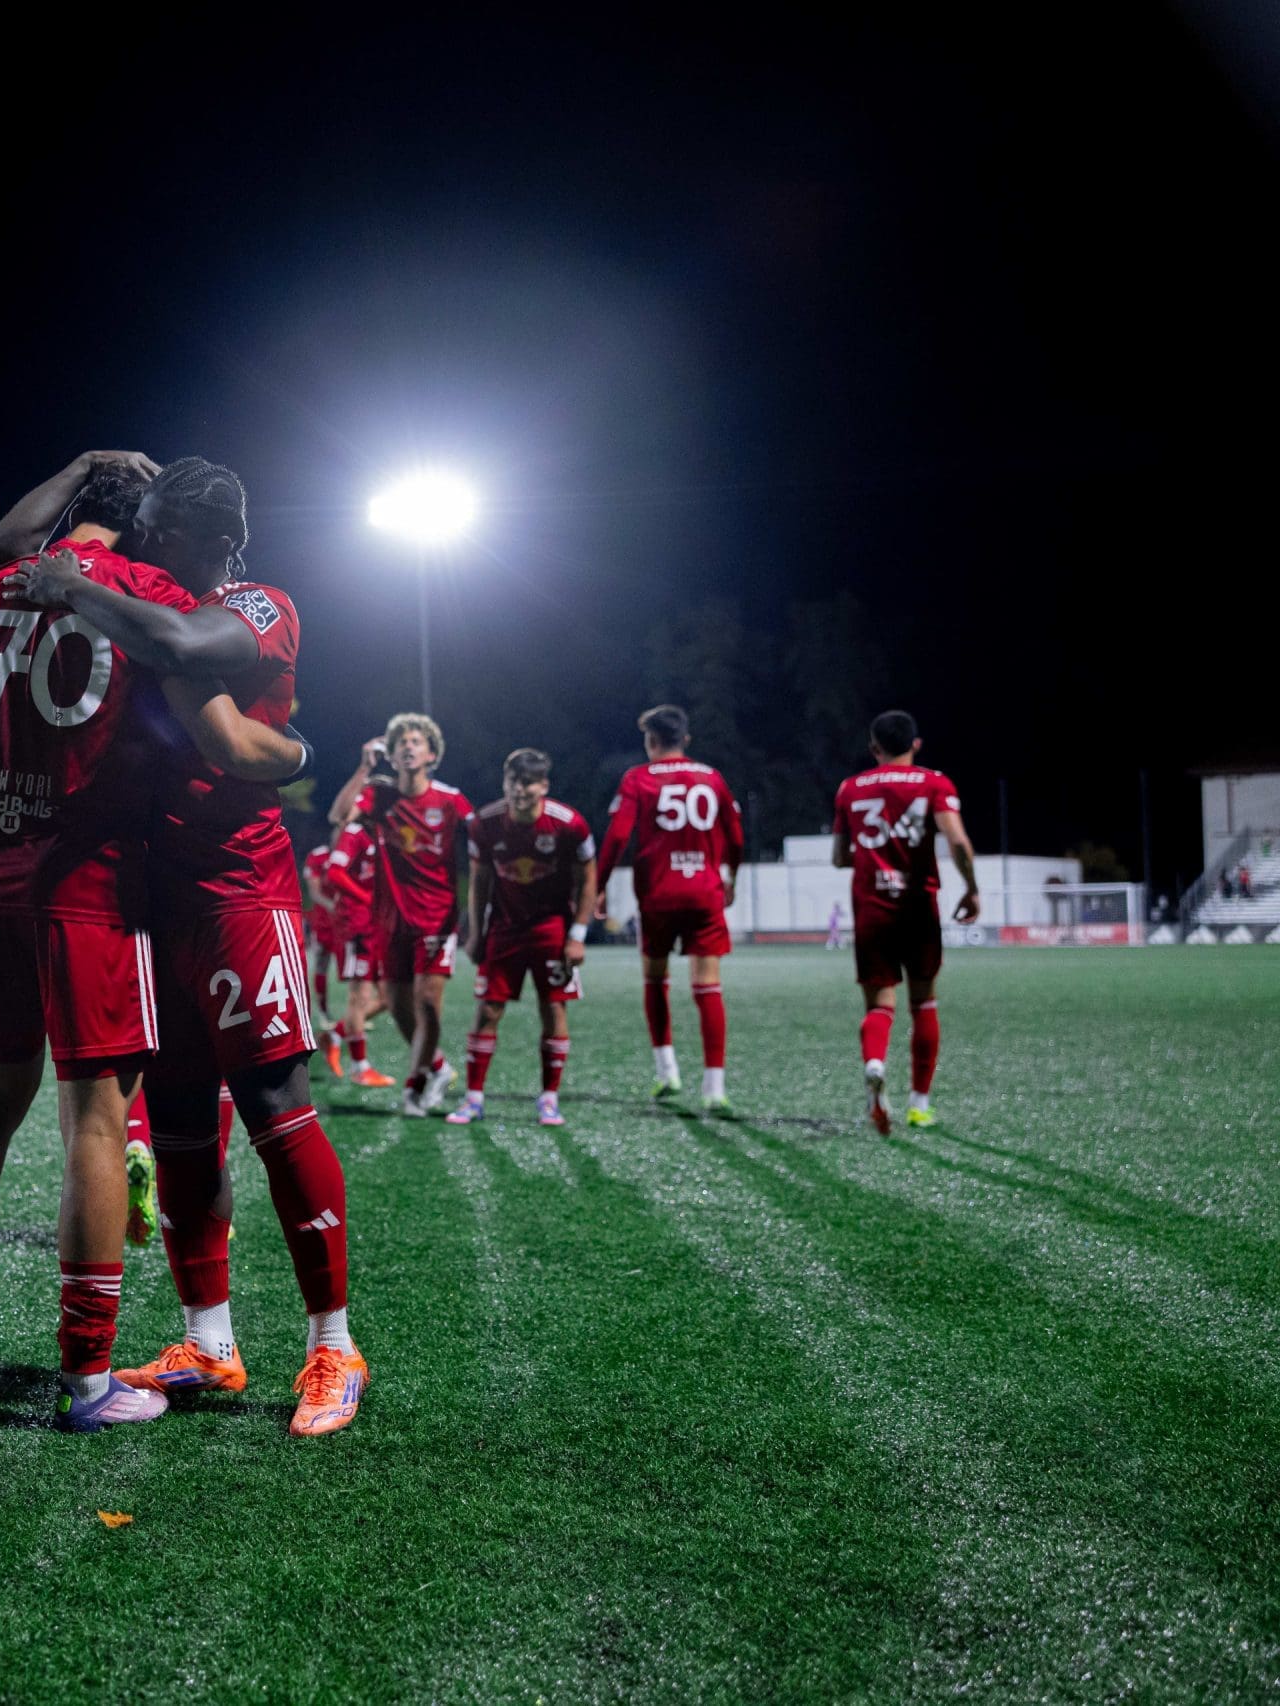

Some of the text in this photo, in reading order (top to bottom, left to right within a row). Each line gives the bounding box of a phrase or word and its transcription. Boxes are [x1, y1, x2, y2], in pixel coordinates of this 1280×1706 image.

[655, 783, 718, 831] 50
[850, 797, 928, 849] 34
[209, 954, 289, 1030] 24
